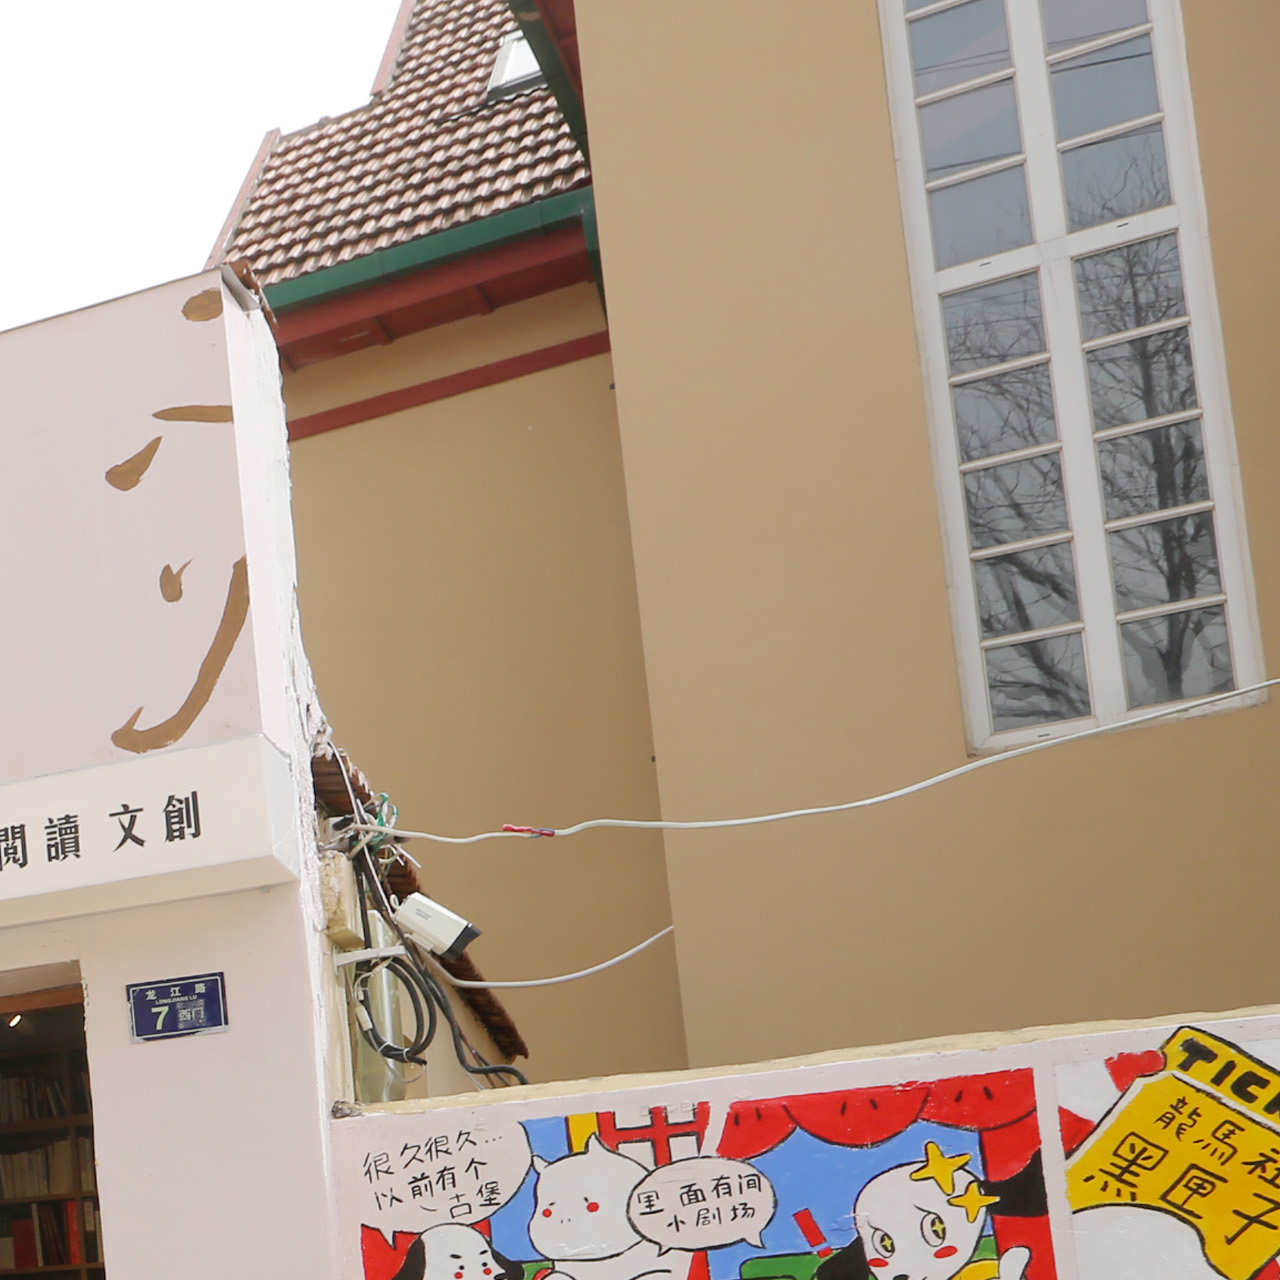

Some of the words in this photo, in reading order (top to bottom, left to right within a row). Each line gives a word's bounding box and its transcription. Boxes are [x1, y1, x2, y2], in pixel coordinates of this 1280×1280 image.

[109, 790, 202, 853] 文創
[145, 982, 207, 1001] 龙江路
[151, 1005, 170, 1031] 7
[373, 1157, 489, 1212] 以前有个
[637, 1174, 763, 1215] 里面有间
[1082, 1131, 1280, 1245] 黑匣子
[666, 1202, 756, 1233] 小剧场
